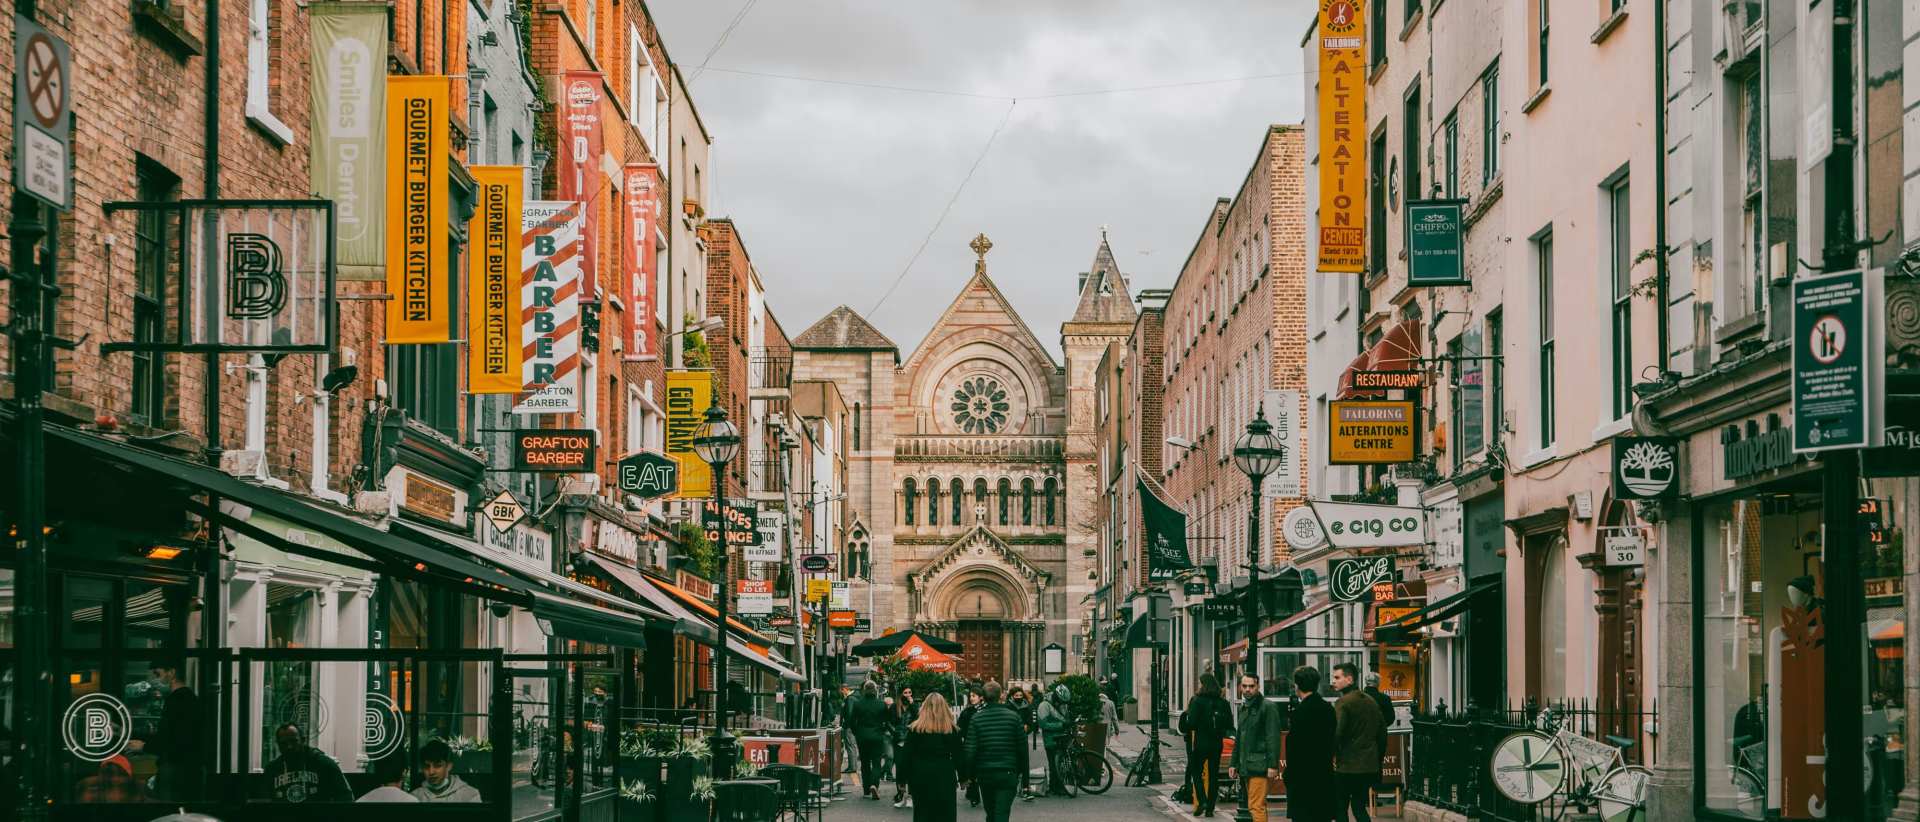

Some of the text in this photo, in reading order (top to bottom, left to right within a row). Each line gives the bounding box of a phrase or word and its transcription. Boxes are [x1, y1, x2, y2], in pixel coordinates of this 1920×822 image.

[1325, 39, 1360, 47] TAILORING
[338, 50, 360, 225] Smiles Dental
[1333, 60, 1351, 226] ALTERATION
[409, 98, 425, 321] GOURMET BURGER KITCHEN
[526, 208, 574, 217] GRAFTON
[527, 220, 569, 229] BARBER
[1414, 223, 1456, 231] CHIFFON
[1324, 229, 1361, 244] CENTRE
[489, 185, 503, 374] GOURMET BURGER KITCHEN
[632, 217, 647, 353] DINER
[532, 235, 558, 385] BARBER
[1356, 373, 1419, 387] RESTAURANT
[534, 387, 573, 396] RAFTON
[527, 399, 569, 407] BARBER
[1345, 408, 1402, 419] TAILORING
[1277, 411, 1288, 440] Clinic
[1339, 425, 1409, 436] ALTERATIONS
[522, 437, 589, 449] GRAFTON
[1353, 439, 1393, 449] CENTRE
[527, 452, 584, 464] BARBER
[622, 462, 674, 491] EAT
[730, 500, 756, 508] WINES
[493, 505, 516, 518] GBK
[1331, 521, 1344, 535] e
[1350, 519, 1384, 538] cig
[1389, 517, 1418, 532] co
[1617, 552, 1634, 561] 30
[1331, 557, 1389, 600] Cave
[1376, 592, 1394, 600] BAR
[86, 709, 113, 748] B
[751, 749, 769, 762] EAT
